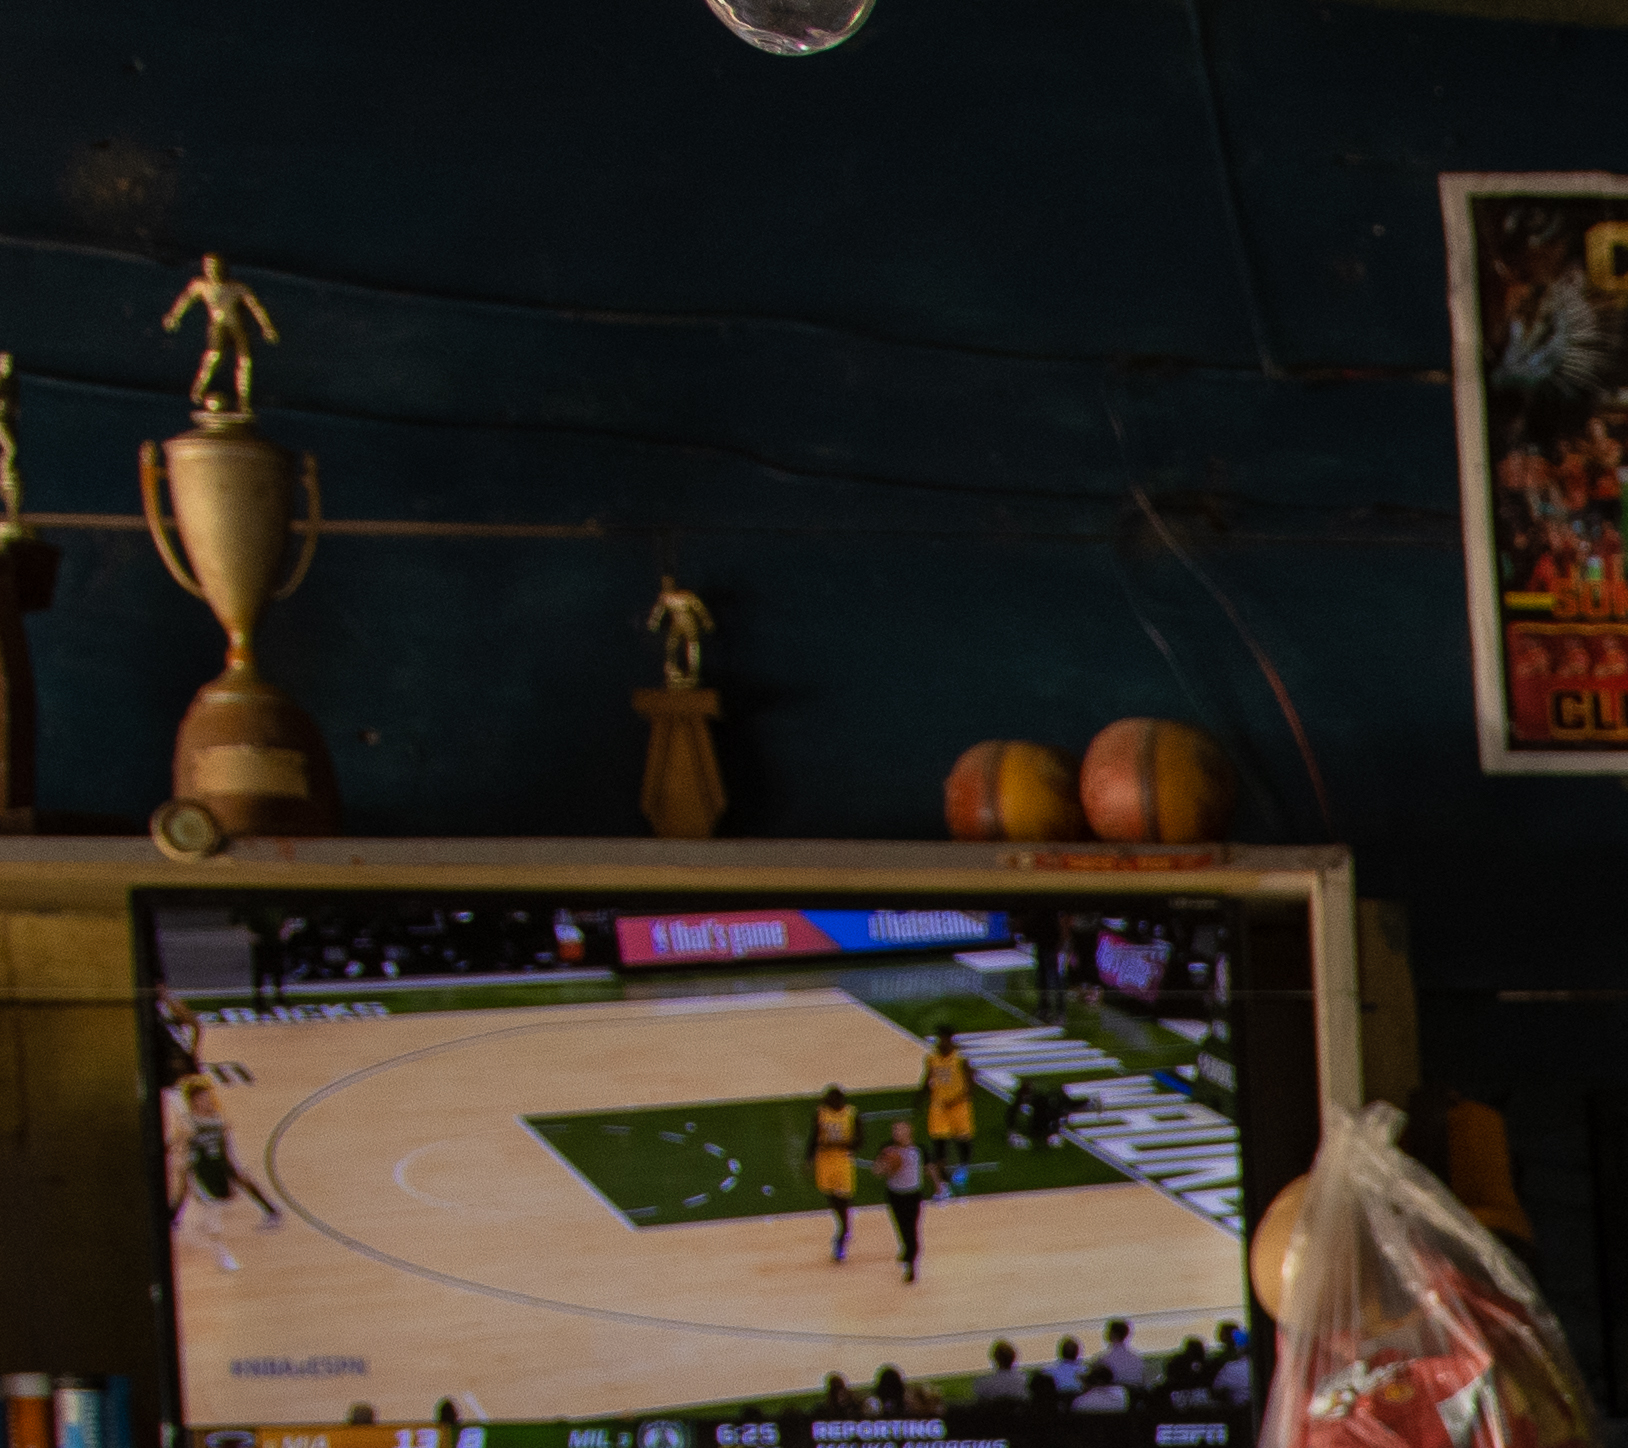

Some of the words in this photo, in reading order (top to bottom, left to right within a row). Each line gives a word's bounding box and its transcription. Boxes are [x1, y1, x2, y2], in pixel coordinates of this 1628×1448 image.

[716, 1422, 782, 1448] 6:25
[811, 1418, 948, 1441] REPORTING
[1153, 1422, 1230, 1448] ESPN
